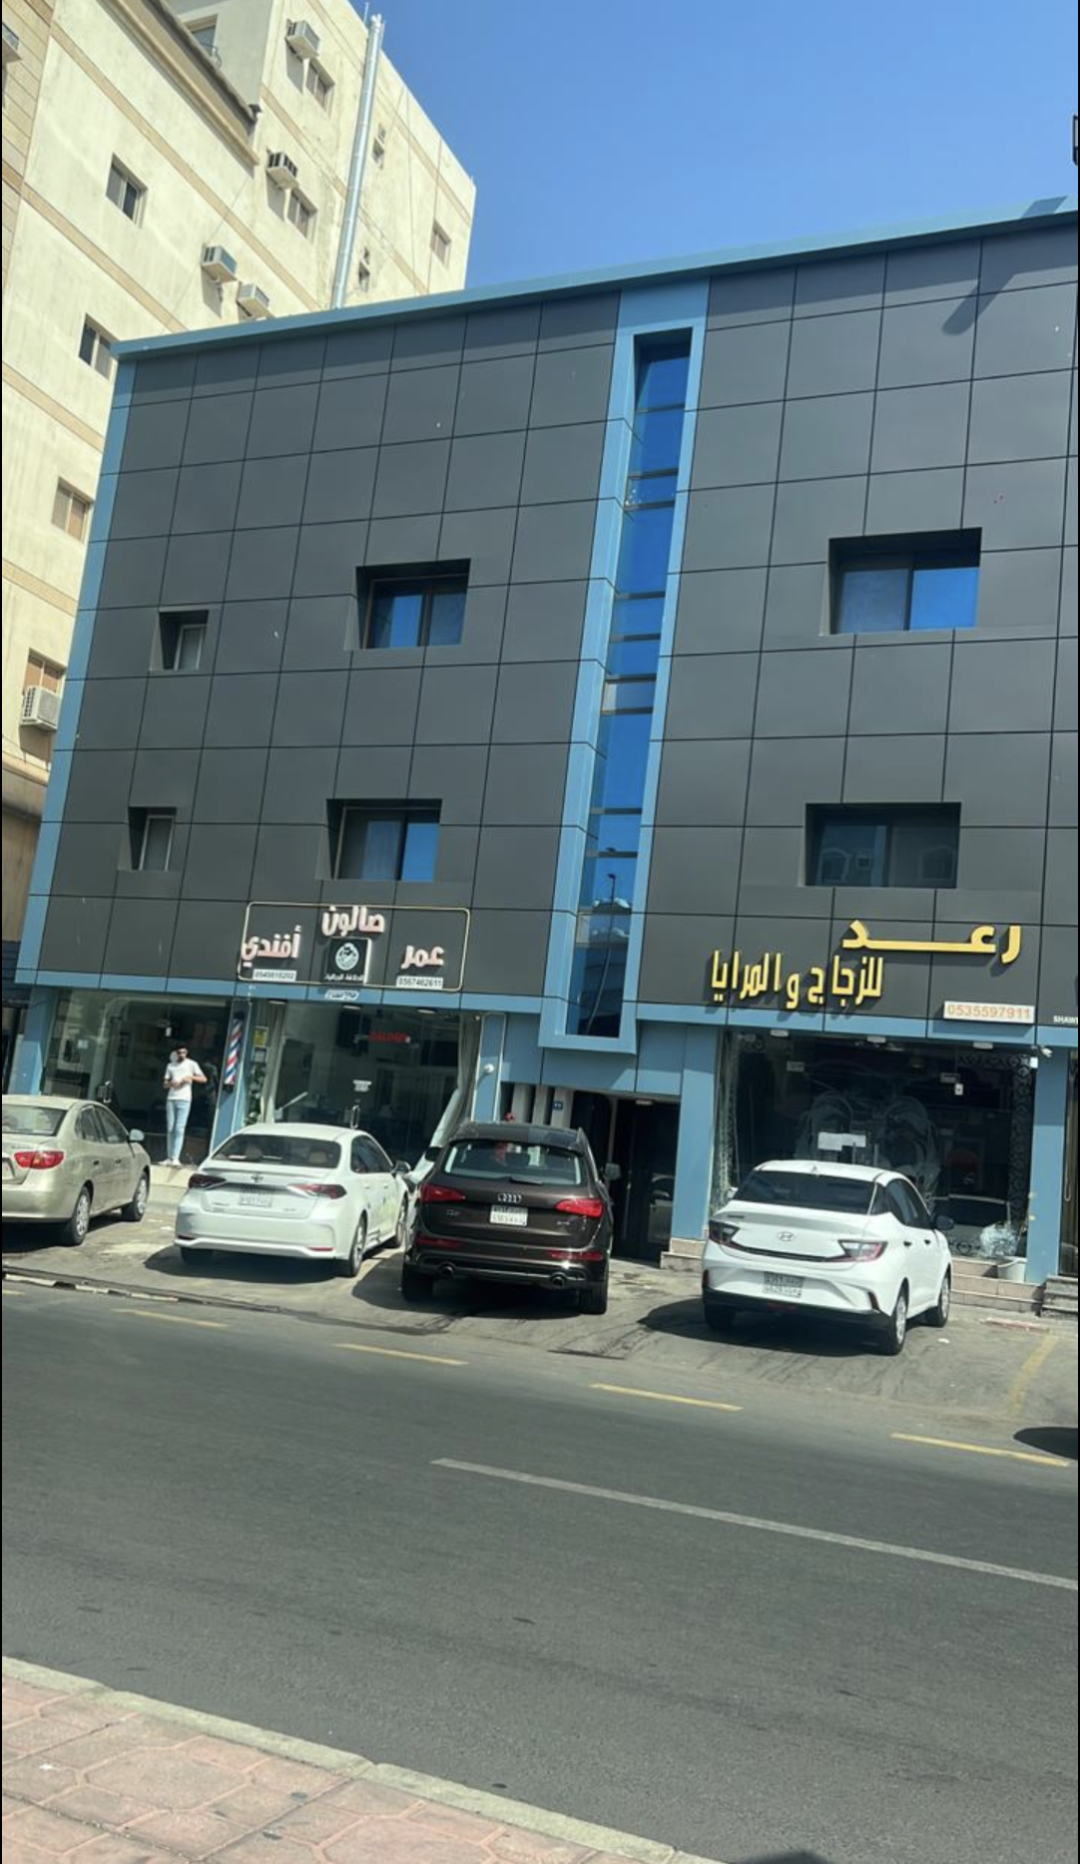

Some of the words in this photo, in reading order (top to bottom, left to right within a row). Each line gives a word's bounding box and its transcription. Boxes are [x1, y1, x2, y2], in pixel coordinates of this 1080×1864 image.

[321, 905, 385, 937] صالون
[241, 924, 302, 967] أفندي
[401, 945, 445, 969] عمر
[842, 920, 1021, 964] رعد
[711, 950, 782, 1002] المرايا
[786, 973, 800, 1009] و
[808, 954, 884, 1005] للزجاج
[947, 1004, 1031, 1020] 0535597911
